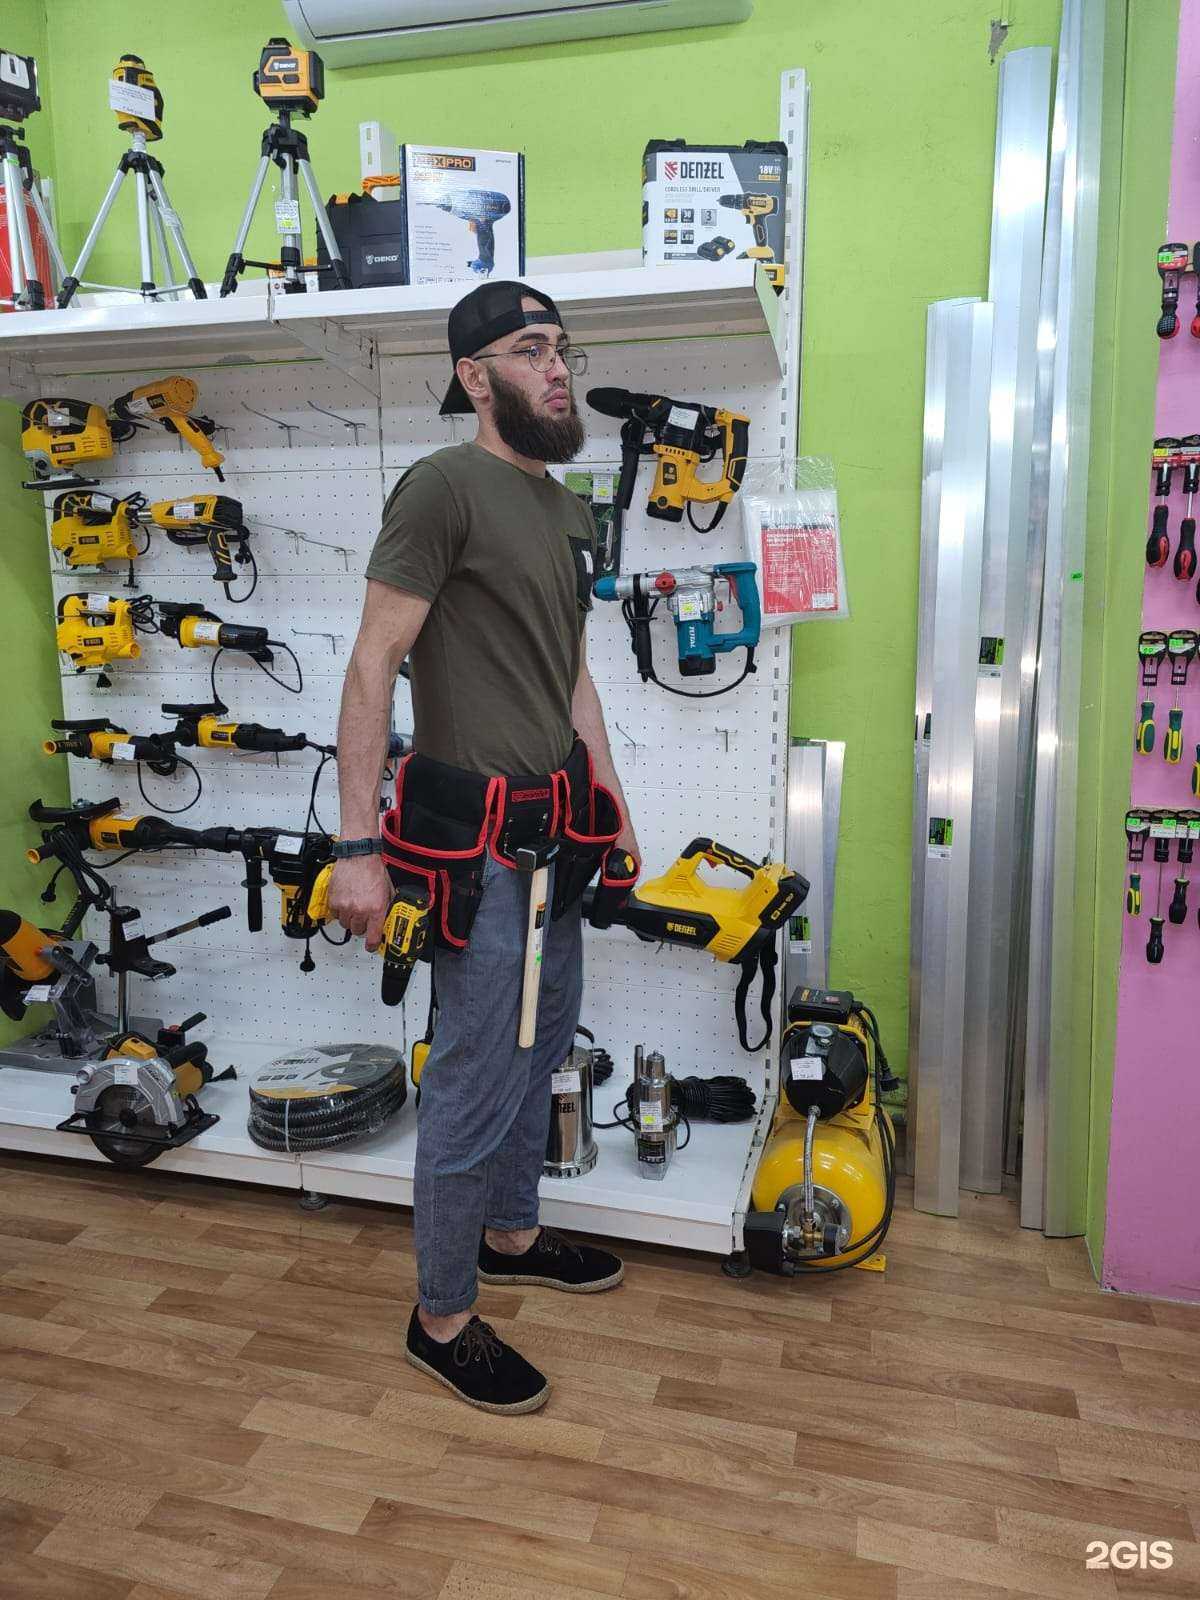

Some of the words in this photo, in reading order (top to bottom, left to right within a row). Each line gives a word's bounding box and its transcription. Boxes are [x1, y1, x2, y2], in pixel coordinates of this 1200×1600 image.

[680, 161, 725, 179] DENZEL
[759, 165, 774, 174] 18V
[705, 210, 712, 221] 3
[374, 255, 399, 263] DEKO
[688, 626, 697, 649] TOTAL
[674, 923, 697, 936] DENZEL
